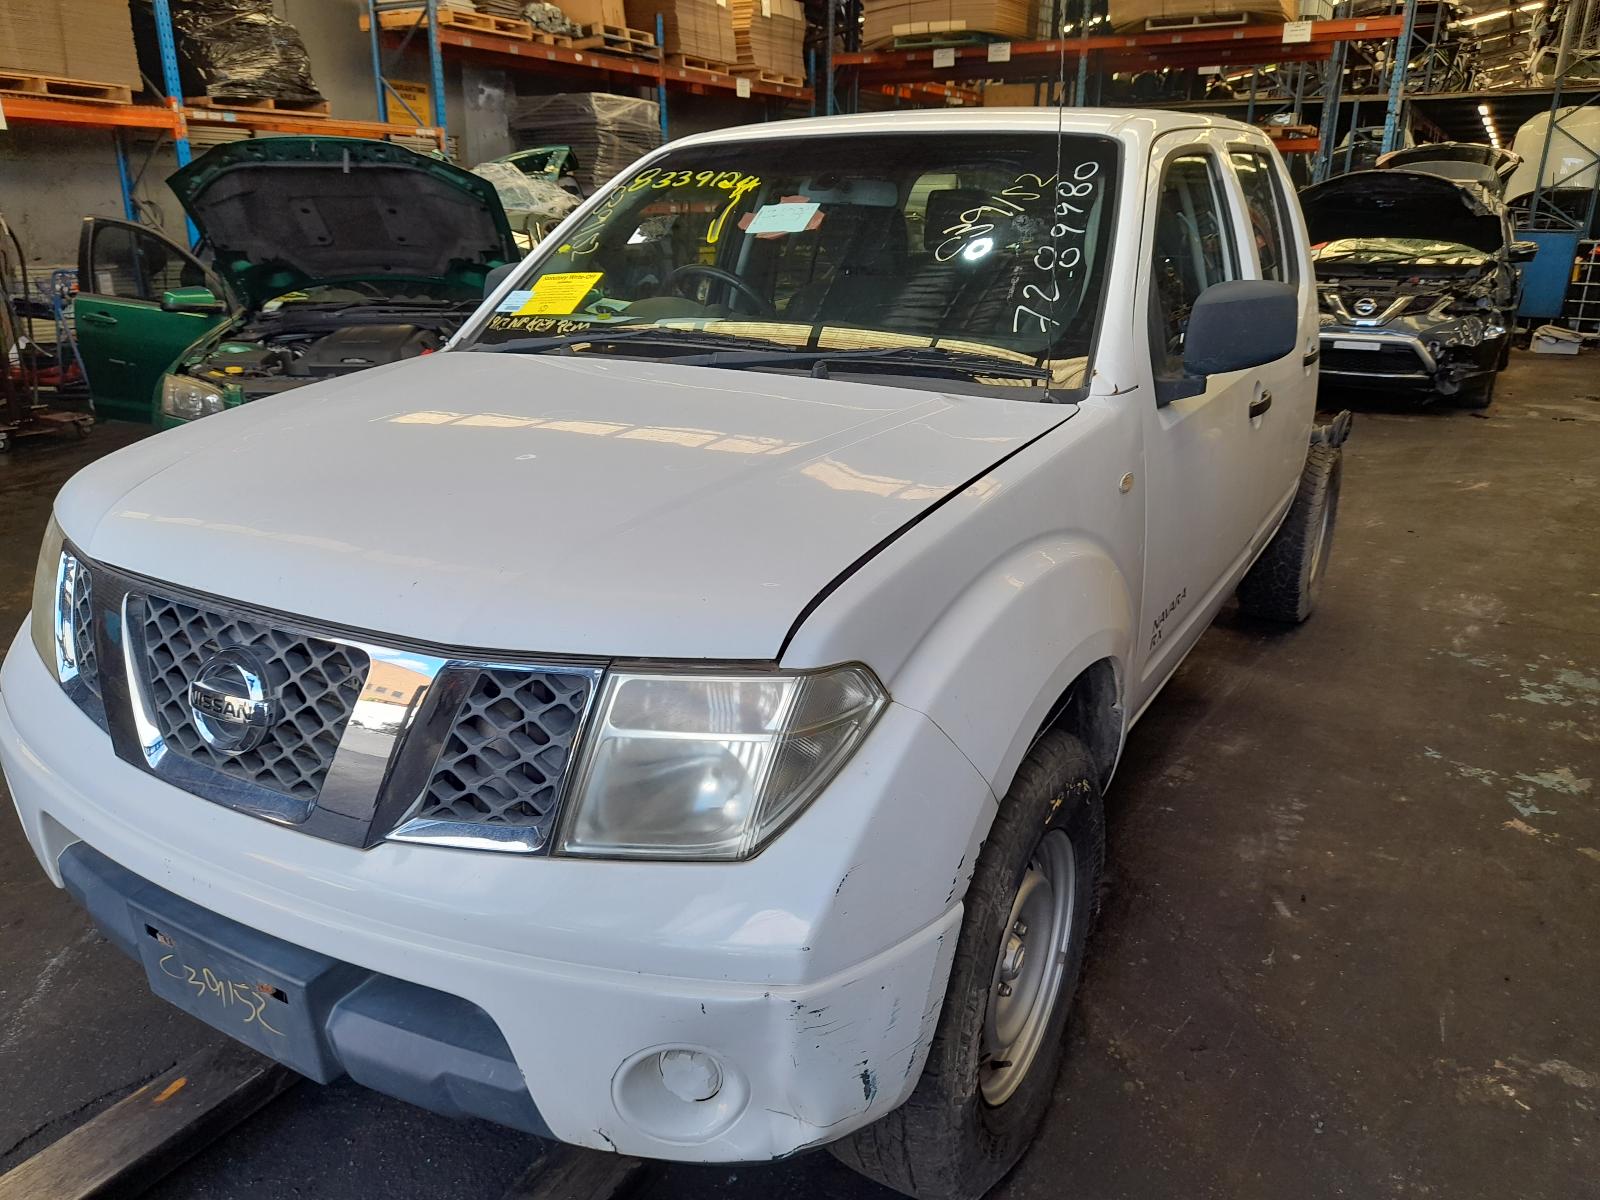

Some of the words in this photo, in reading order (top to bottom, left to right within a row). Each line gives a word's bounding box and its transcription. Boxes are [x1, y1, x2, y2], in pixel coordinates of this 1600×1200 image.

[1151, 586, 1187, 634] NAVARA
[190, 689, 253, 721] NISSAN
[159, 954, 287, 1037] C39152
